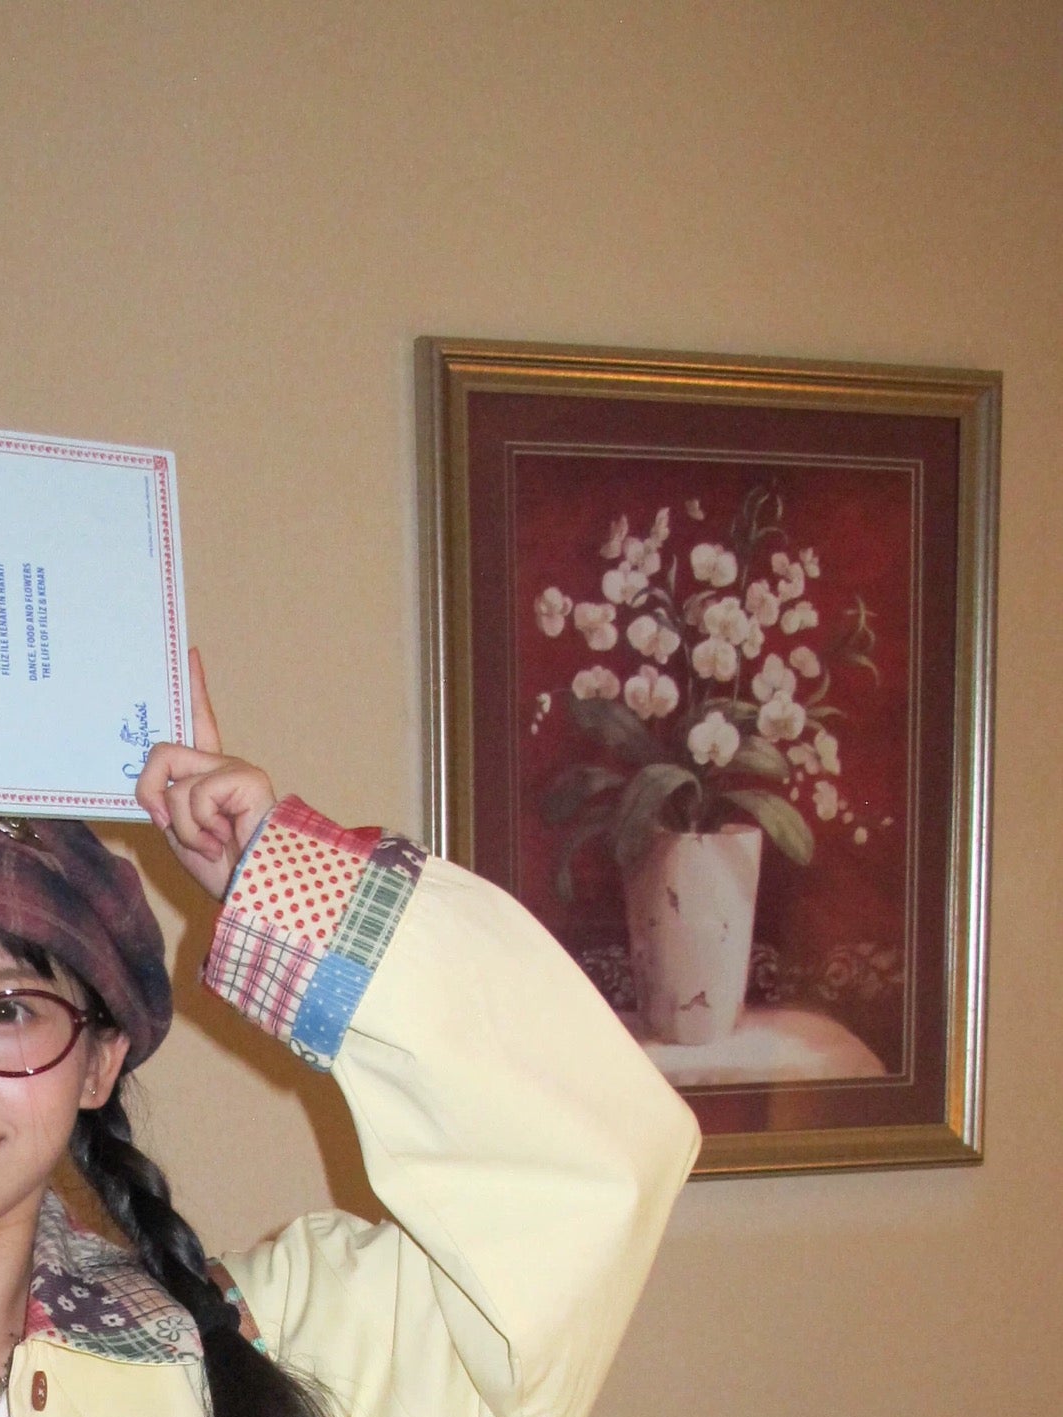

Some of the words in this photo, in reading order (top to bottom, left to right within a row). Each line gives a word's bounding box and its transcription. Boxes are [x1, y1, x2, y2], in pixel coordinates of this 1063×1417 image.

[22, 562, 33, 602] FLOWERS
[36, 566, 46, 598] KENAN
[25, 604, 34, 623] AND
[26, 625, 35, 649] FOOD
[40, 631, 49, 641] OF
[40, 642, 50, 661] LIFE
[27, 650, 37, 681] DANCE,
[41, 662, 51, 679] THE
